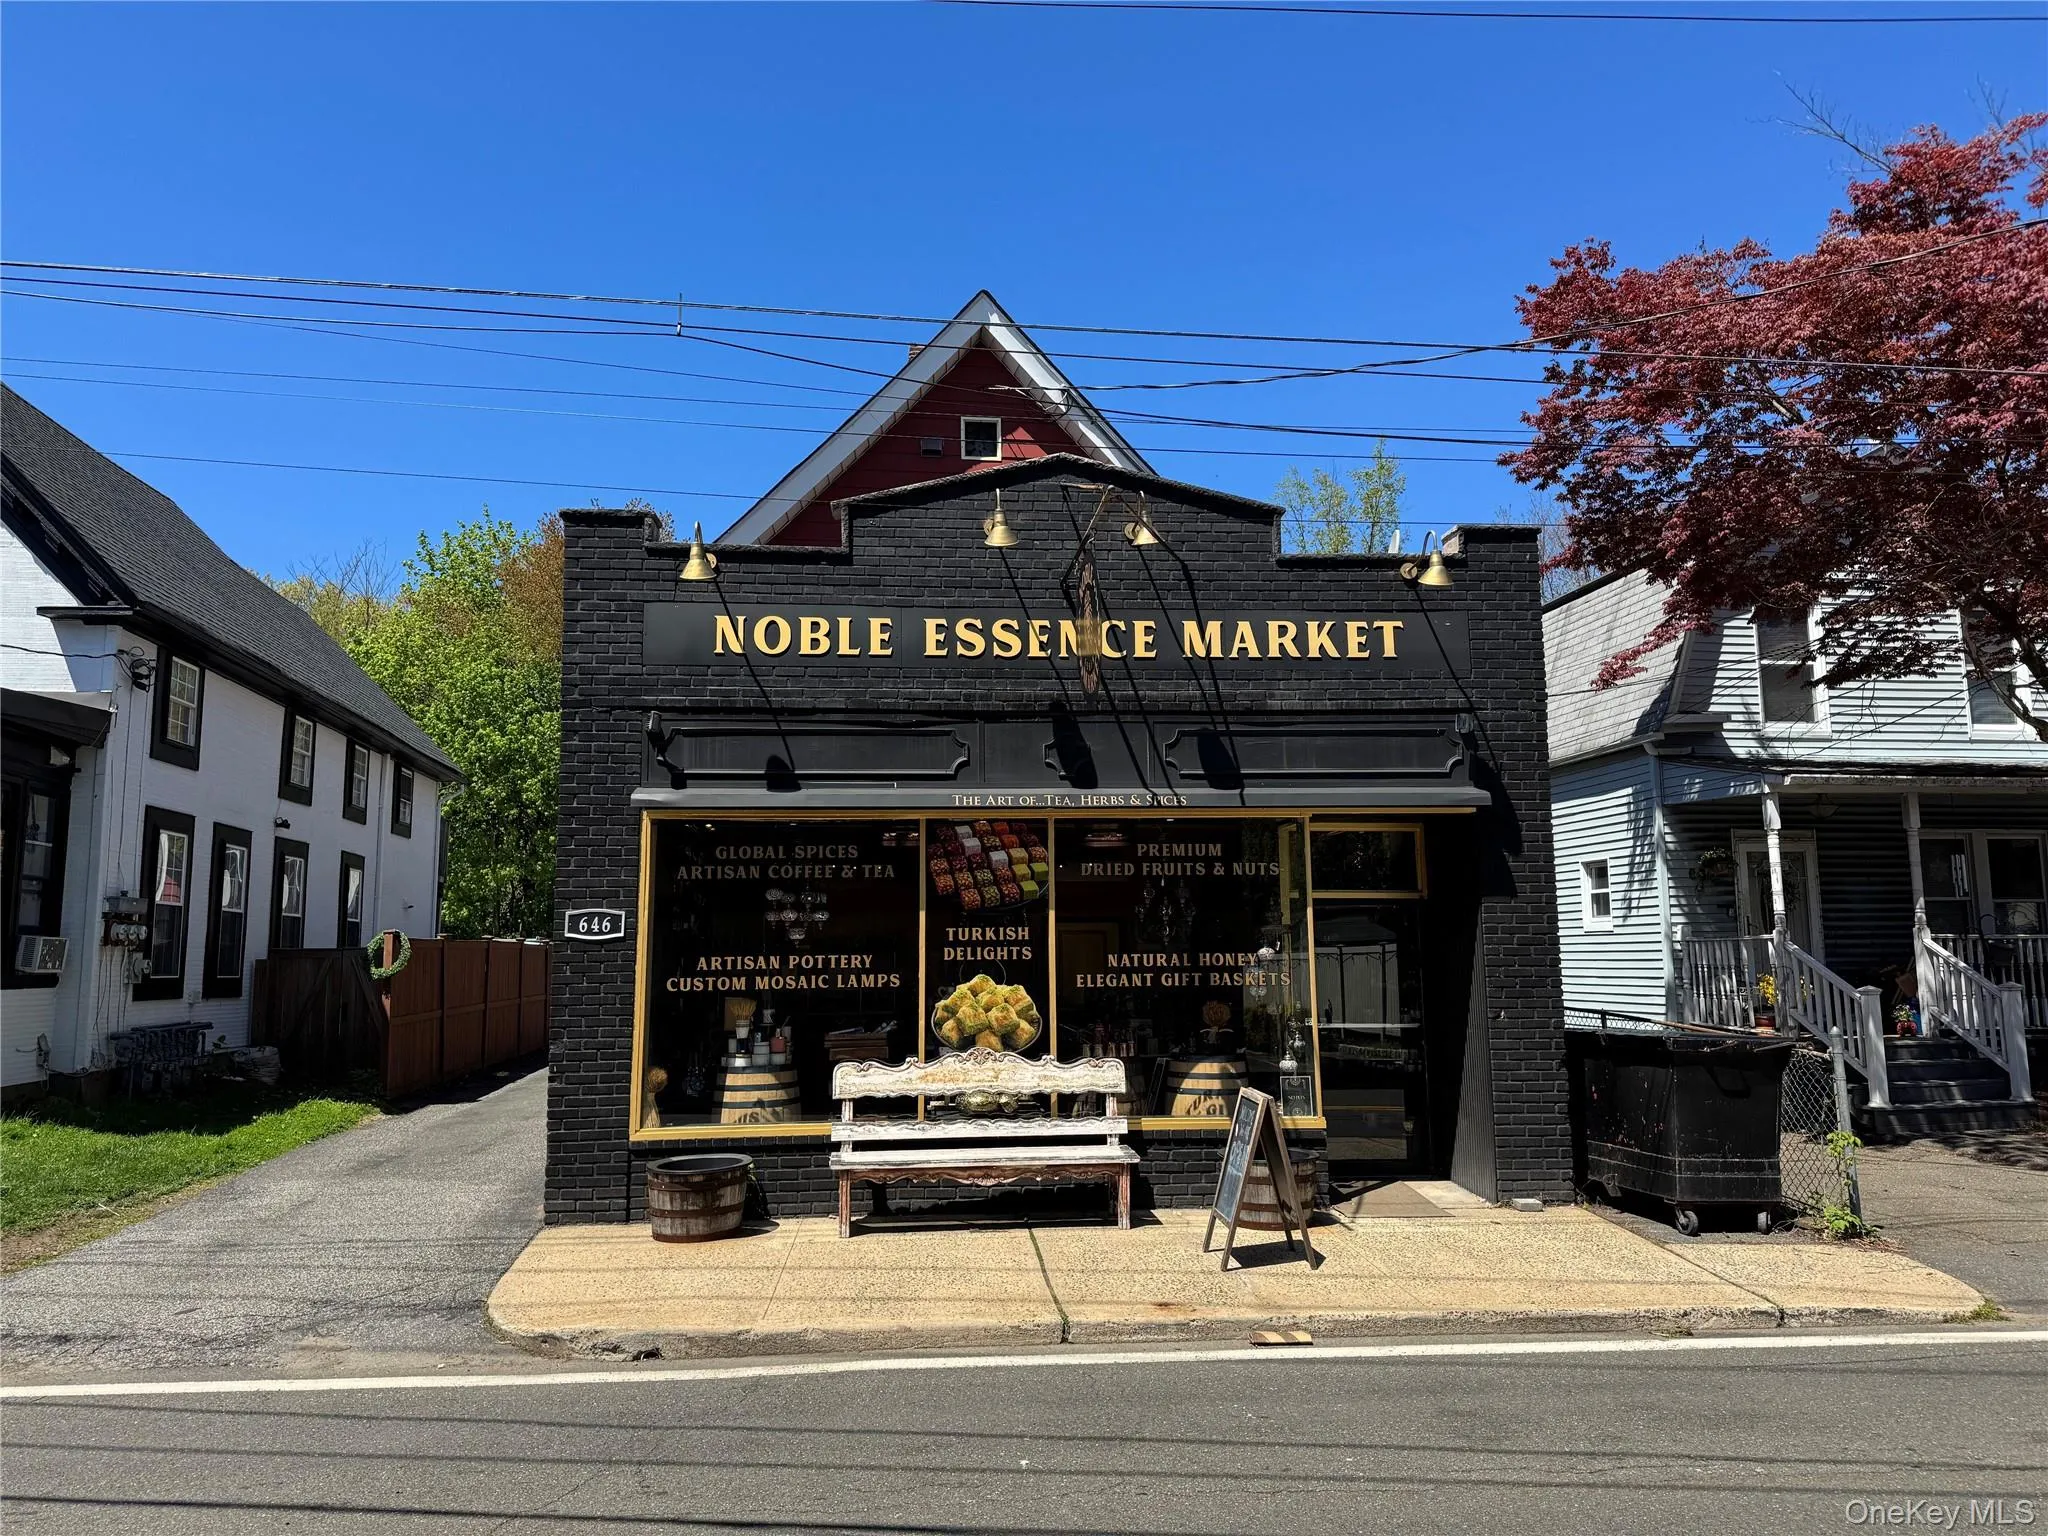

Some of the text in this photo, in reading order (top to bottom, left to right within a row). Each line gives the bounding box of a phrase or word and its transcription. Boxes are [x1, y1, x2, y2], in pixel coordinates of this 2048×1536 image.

[713, 615, 894, 658] NOBLE
[1181, 618, 1405, 659] MARKET
[952, 794, 981, 806] THE
[986, 794, 1014, 806] ART
[1081, 794, 1125, 806] HERBS
[1130, 794, 1142, 806] &
[715, 845, 858, 860] GLOBAL SPICES
[1137, 843, 1222, 857] PREMIUM
[677, 864, 895, 880] ARTISAN COFFEE & TEA
[1081, 862, 1280, 876] DRIED FRUITS & NUTS
[578, 916, 611, 933] 646
[945, 926, 1029, 942] TURKISH
[943, 946, 1033, 961] DELIGHTS
[1107, 952, 1258, 968] NATURAL HONEY
[696, 954, 873, 971] ARTISAN POTTERY
[666, 973, 901, 992] CUSTOM MOSAIC LAMPS
[1076, 971, 1292, 988] ELEGANT GIFT BASKETS
